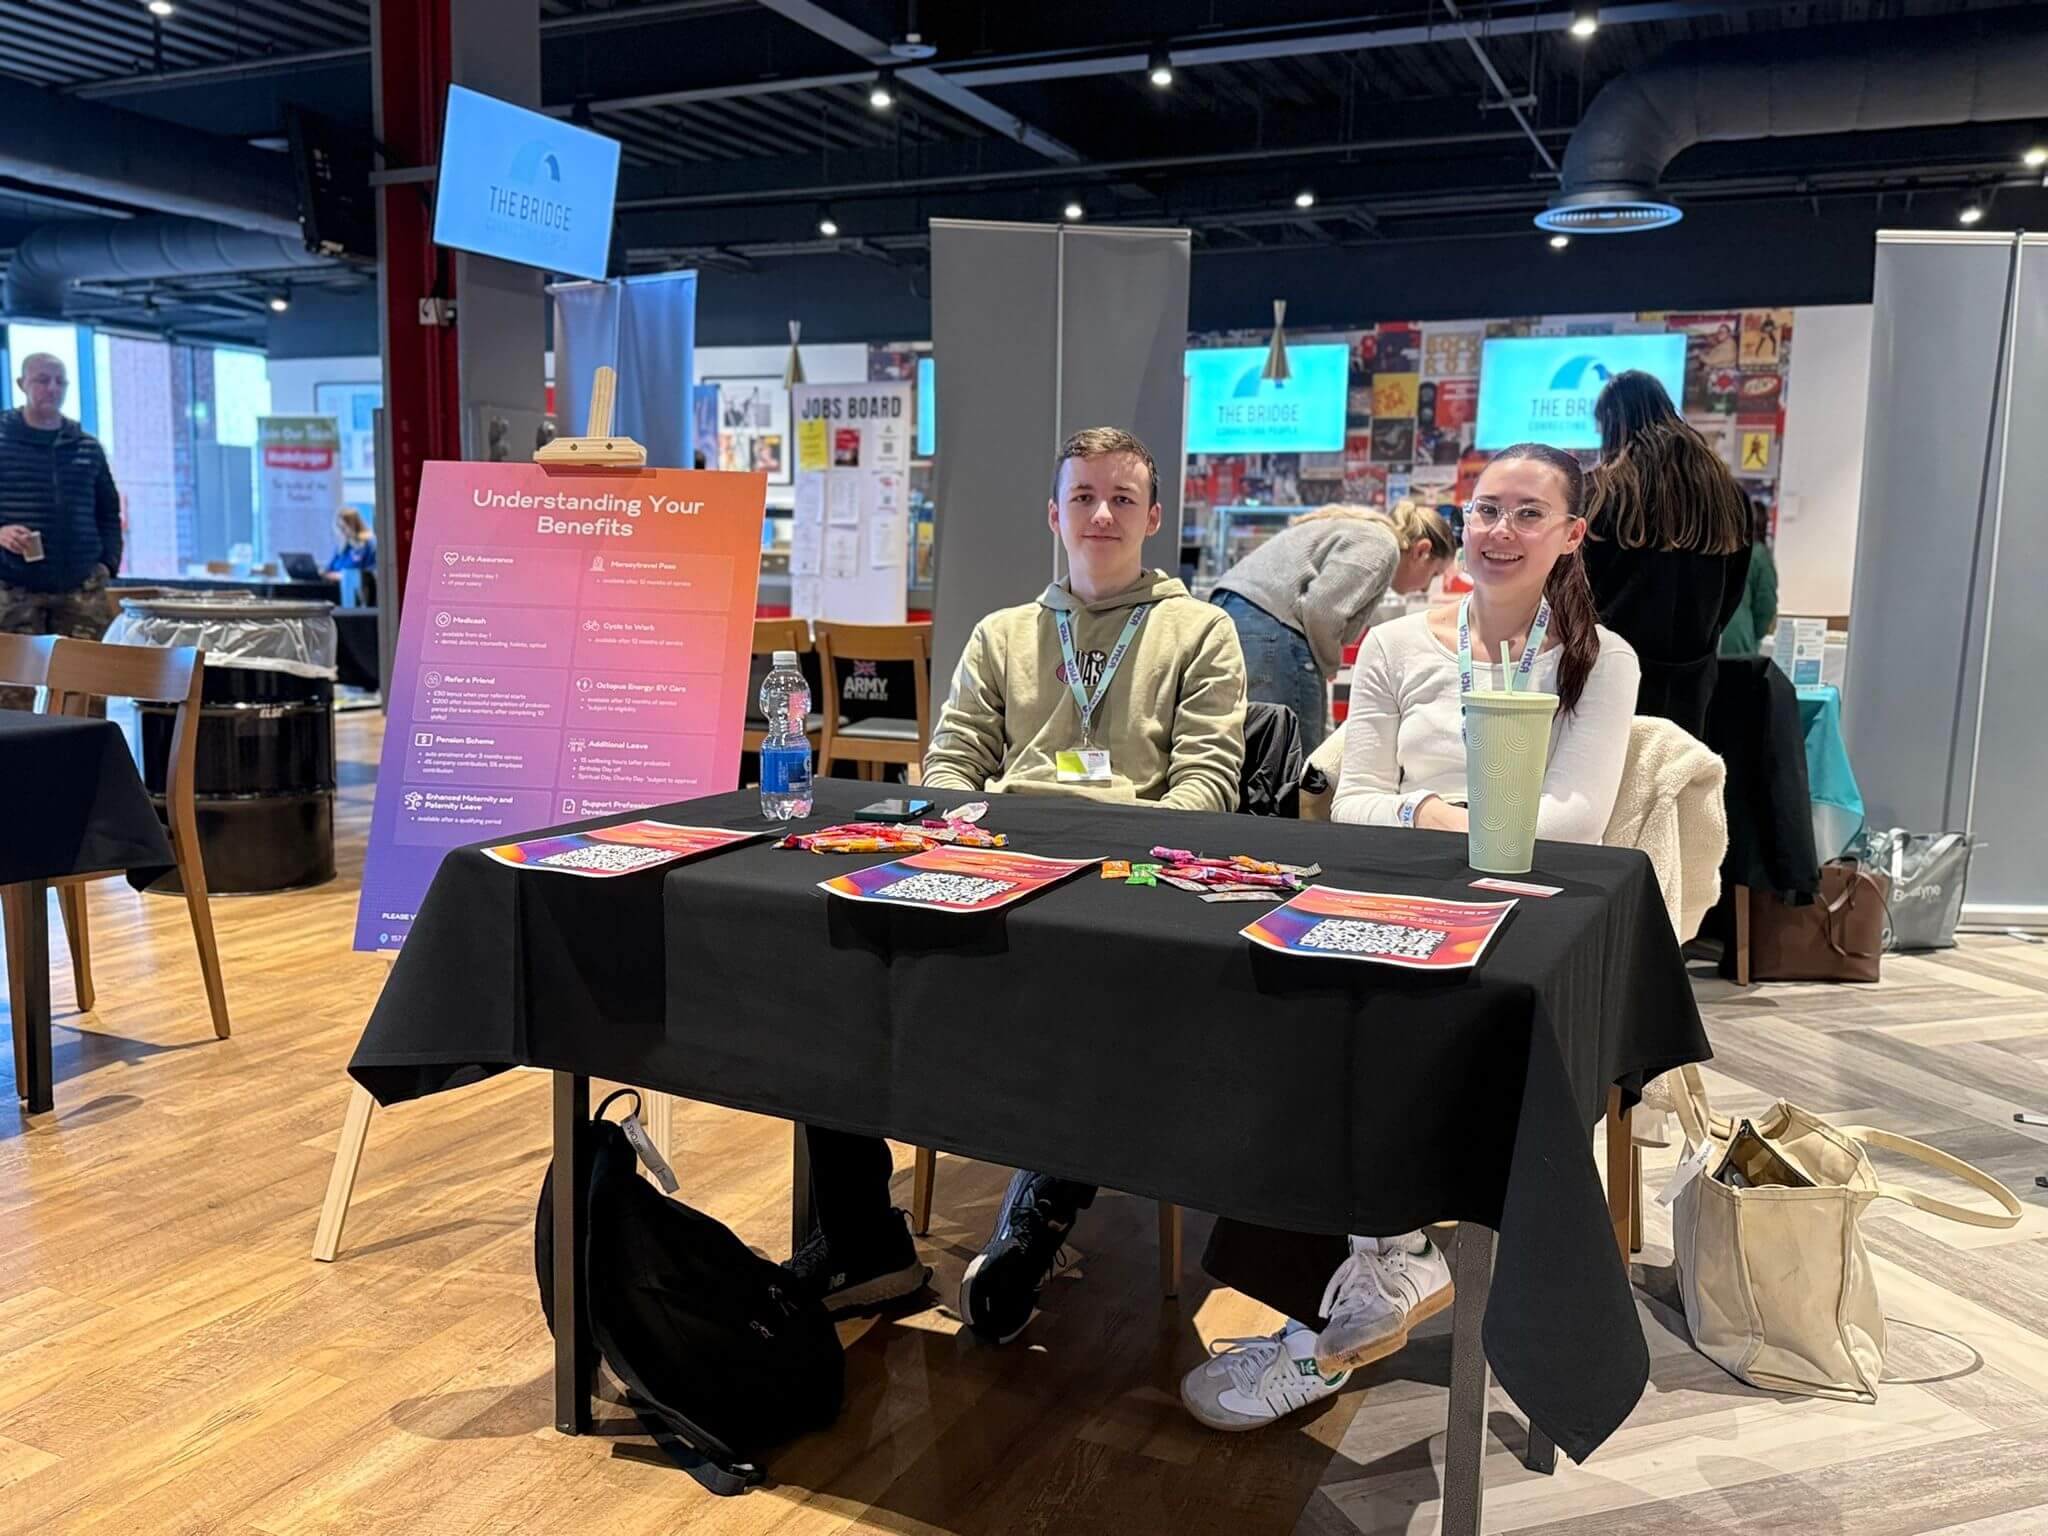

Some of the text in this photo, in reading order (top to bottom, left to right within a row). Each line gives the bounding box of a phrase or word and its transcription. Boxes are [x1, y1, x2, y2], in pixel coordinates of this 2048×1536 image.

[490, 185, 572, 232] THE BRIDGE
[801, 396, 902, 419] JOBS BOARD
[1218, 403, 1299, 424] THE BRIDGE
[1532, 398, 1595, 417] THE BRI
[473, 489, 705, 517] Understanding Your
[537, 516, 634, 537] Benefits
[461, 555, 514, 564] Life Assurance
[610, 560, 677, 570] Merseytravel Pass
[452, 616, 487, 624] Medicash
[1130, 604, 1147, 627] YMCA
[603, 622, 655, 632] Cycle to Work
[1459, 624, 1470, 651] YMCA
[1107, 644, 1126, 669] YMCA
[1519, 647, 1537, 673] YMCA
[1067, 658, 1080, 685] YMCA
[596, 682, 627, 691] Octopus
[669, 685, 687, 693] Cars
[843, 676, 888, 692] ARMY
[1461, 671, 1471, 693] MCA
[465, 737, 495, 745] Scheme
[588, 740, 649, 750] Additional Leave
[424, 801, 483, 811] Paternity Leave
[426, 793, 461, 802] Enhanced
[462, 795, 498, 804] Maternity
[582, 800, 612, 808] Support
[382, 912, 410, 920] PLEASE
